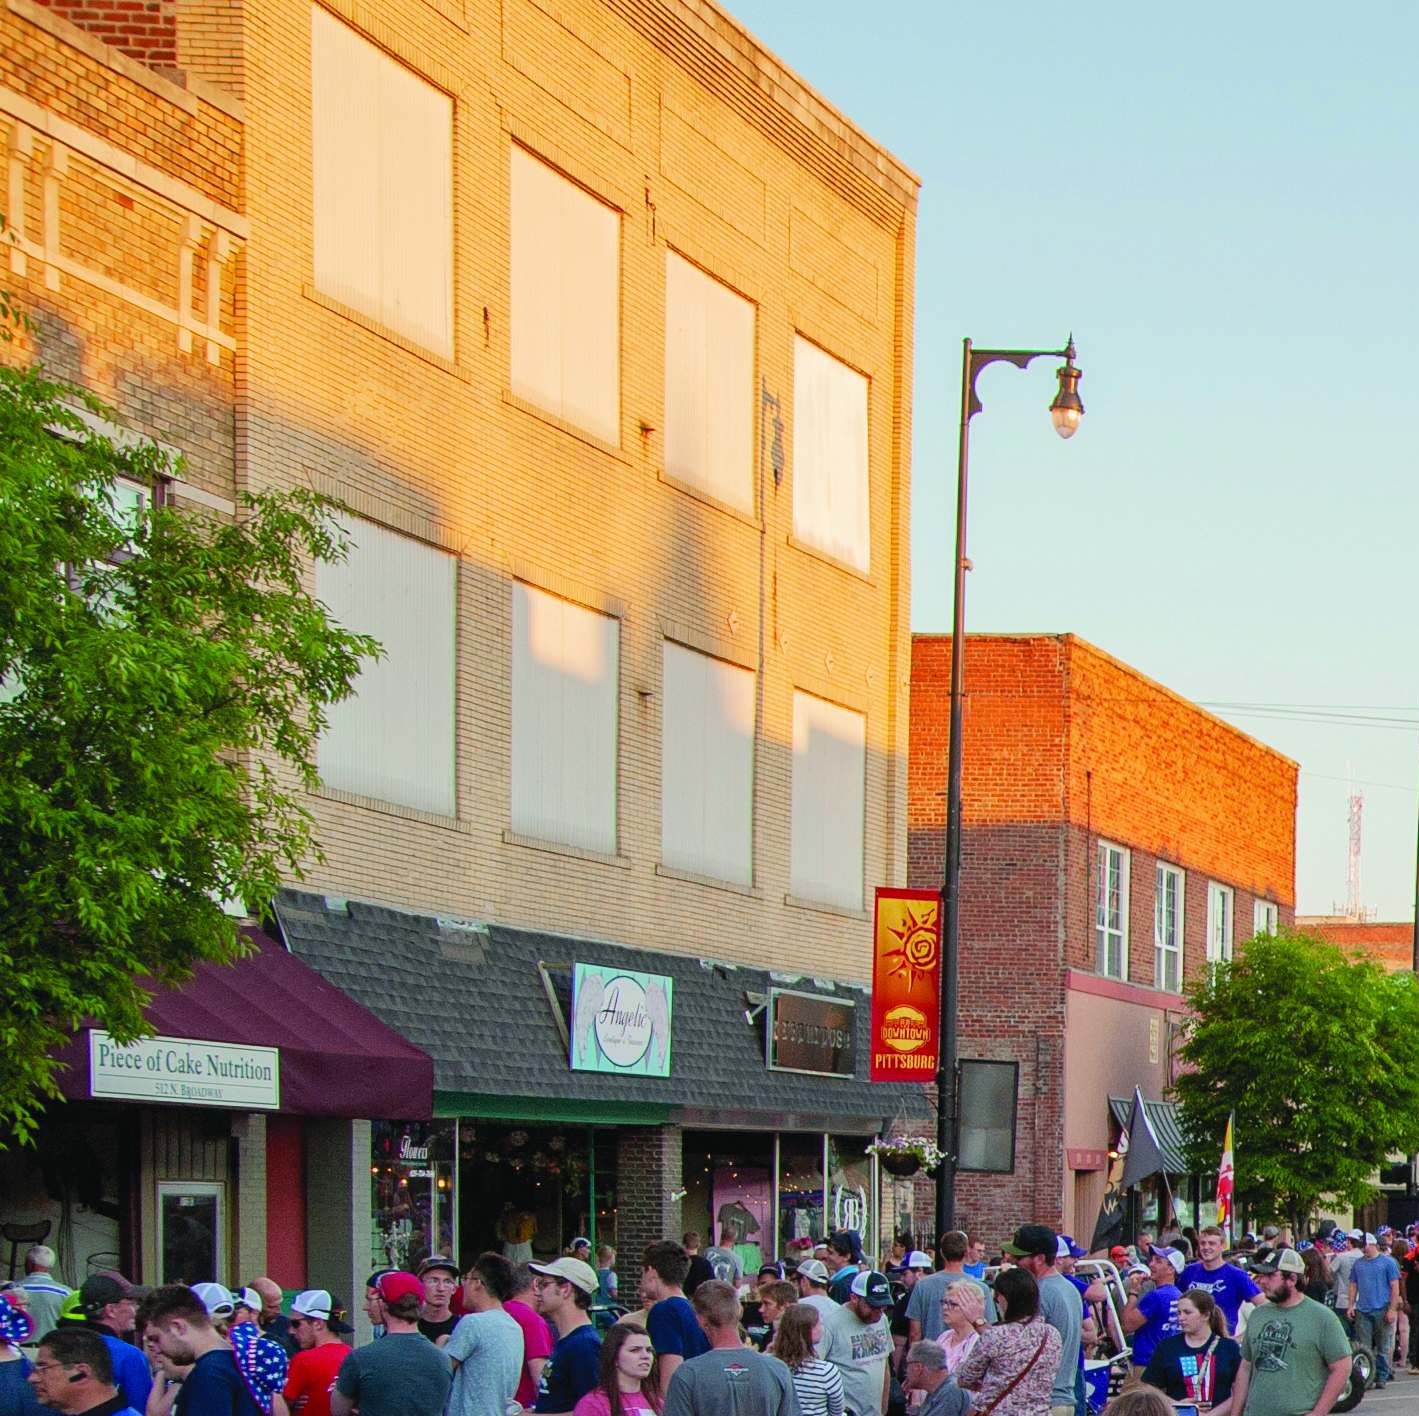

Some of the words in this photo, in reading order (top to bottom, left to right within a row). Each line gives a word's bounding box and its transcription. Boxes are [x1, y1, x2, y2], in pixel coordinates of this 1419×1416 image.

[600, 986, 647, 1037] Angelic
[882, 1027, 930, 1041] DOWNTOWN
[99, 1043, 142, 1070] Piece
[146, 1050, 162, 1072] of
[166, 1050, 203, 1075] Cake
[206, 1054, 272, 1081] Nutrition
[875, 1053, 935, 1070] PITTSBURG
[155, 1083, 168, 1095] 512
[180, 1084, 223, 1098] BROADWAY
